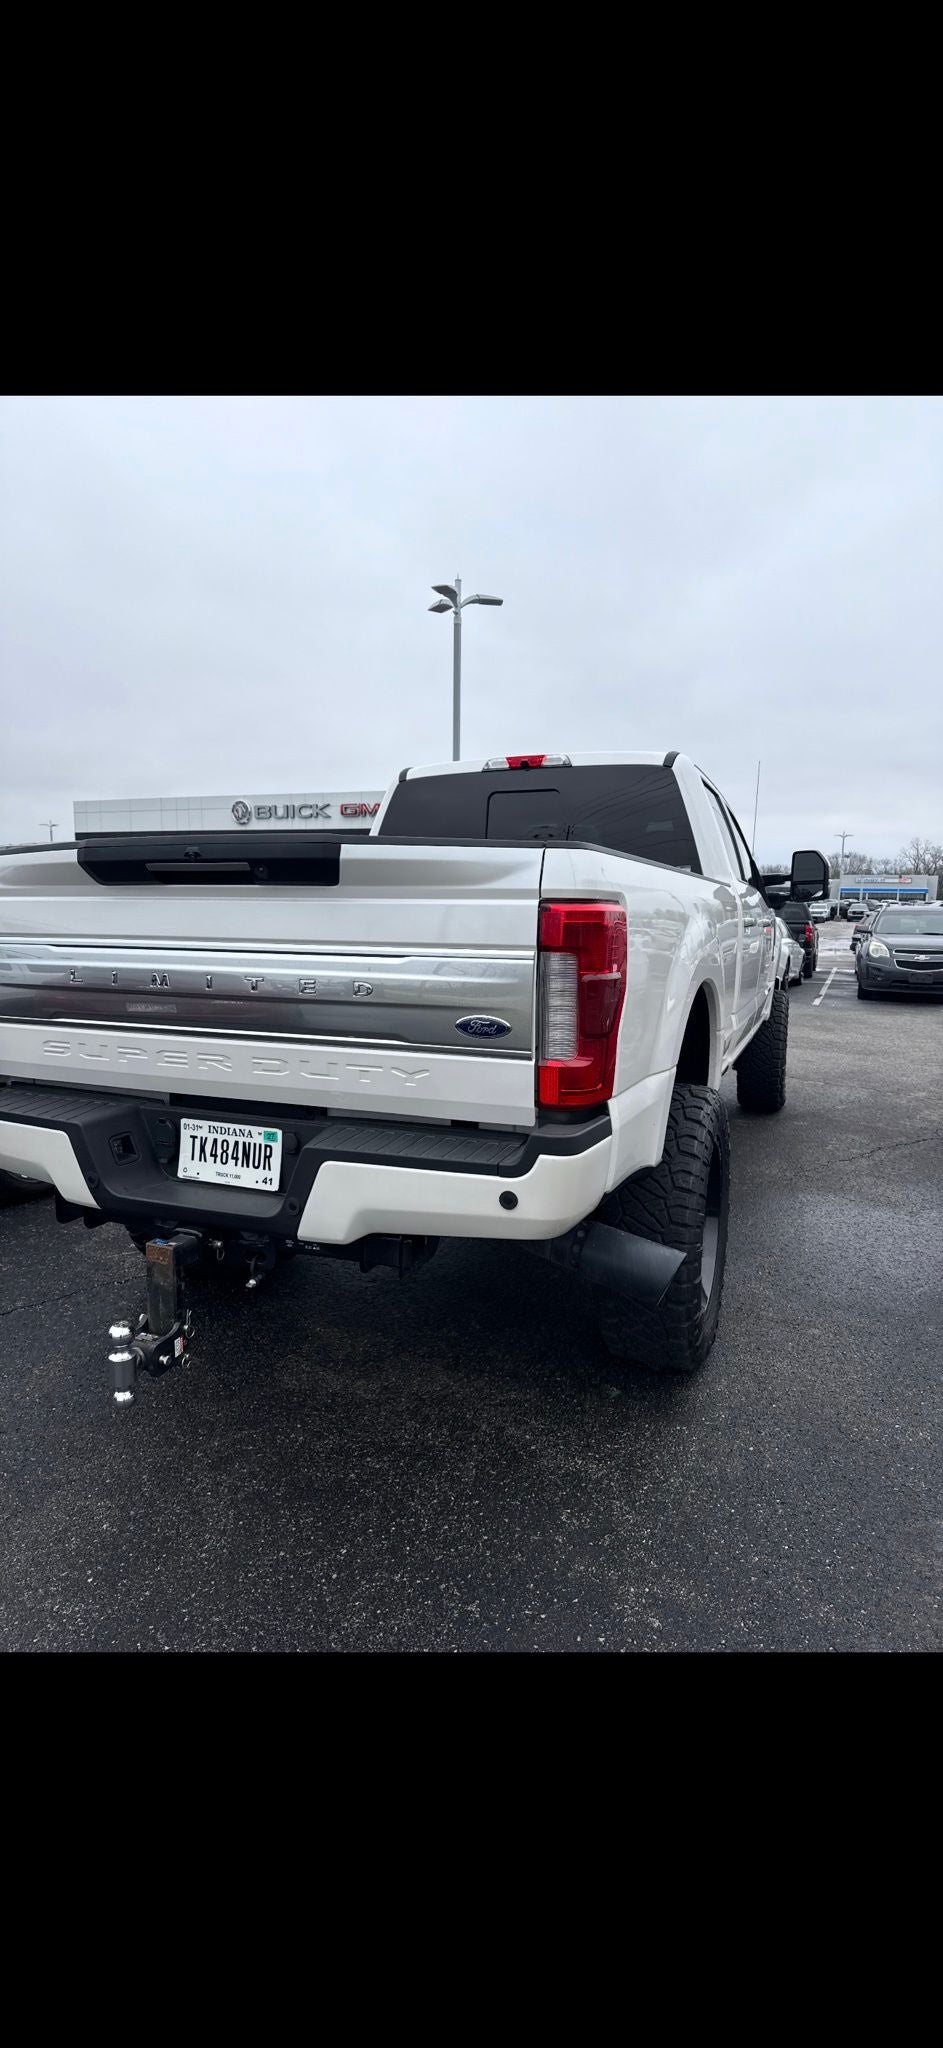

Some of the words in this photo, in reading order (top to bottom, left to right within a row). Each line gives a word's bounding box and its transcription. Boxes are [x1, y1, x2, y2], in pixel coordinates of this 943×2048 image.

[254, 803, 331, 820] BUICK
[70, 968, 375, 998] LIMITED
[467, 1020, 498, 1034] Ford
[42, 1039, 233, 1072] SUPER
[251, 1056, 430, 1086] DUTY
[183, 1123, 199, 1132] 01-31
[208, 1125, 253, 1139] INDIANA
[189, 1135, 273, 1172] TK484NUR
[262, 1177, 273, 1186] 41
